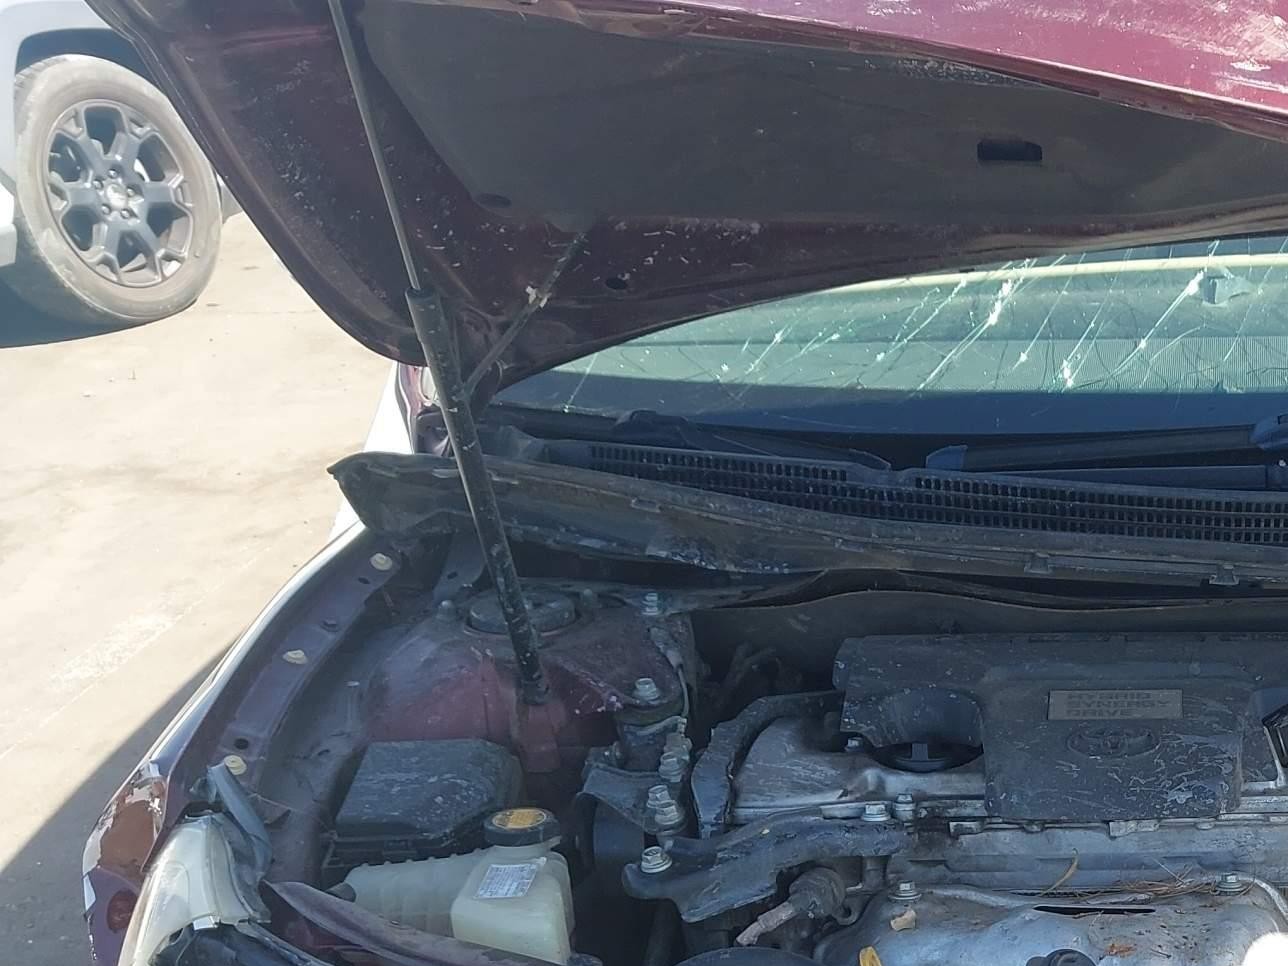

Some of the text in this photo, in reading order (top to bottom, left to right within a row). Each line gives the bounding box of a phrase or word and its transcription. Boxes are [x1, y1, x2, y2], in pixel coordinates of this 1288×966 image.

[1067, 692, 1152, 700] HYBRID
[1066, 700, 1170, 708] SYNERGY
[1066, 708, 1132, 717] DRIVE
